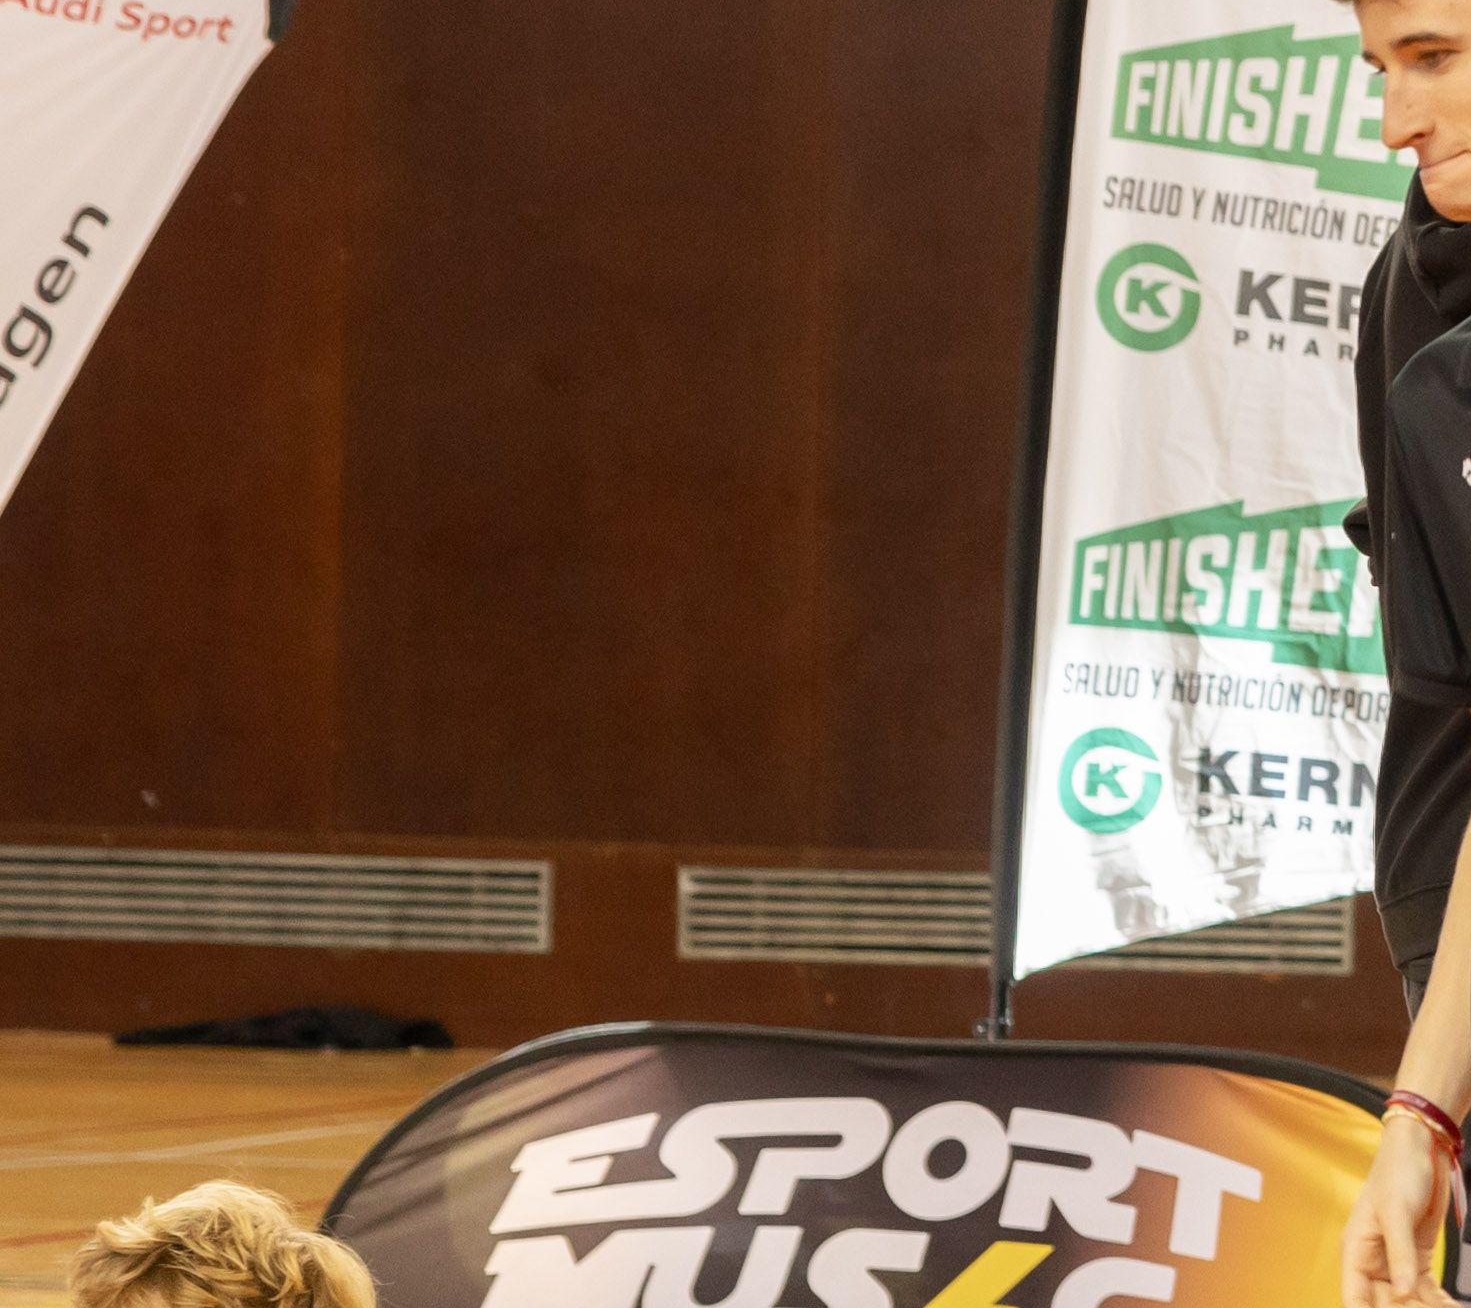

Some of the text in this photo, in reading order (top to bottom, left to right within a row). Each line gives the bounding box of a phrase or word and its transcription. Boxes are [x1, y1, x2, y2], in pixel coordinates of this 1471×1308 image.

[116, 0, 234, 44] Sport
[1124, 54, 1418, 166] FINISHE
[1103, 176, 1182, 216] SALUD
[1190, 188, 1205, 220] Y
[1211, 191, 1347, 241] NUTRICIÓN
[1063, 663, 1140, 698] SALUD
[1151, 669, 1164, 700] Y
[1171, 670, 1300, 713] NUTRICIÓN
[1199, 806, 1373, 836] PHARM
[489, 1097, 1263, 1261] ESPORT
